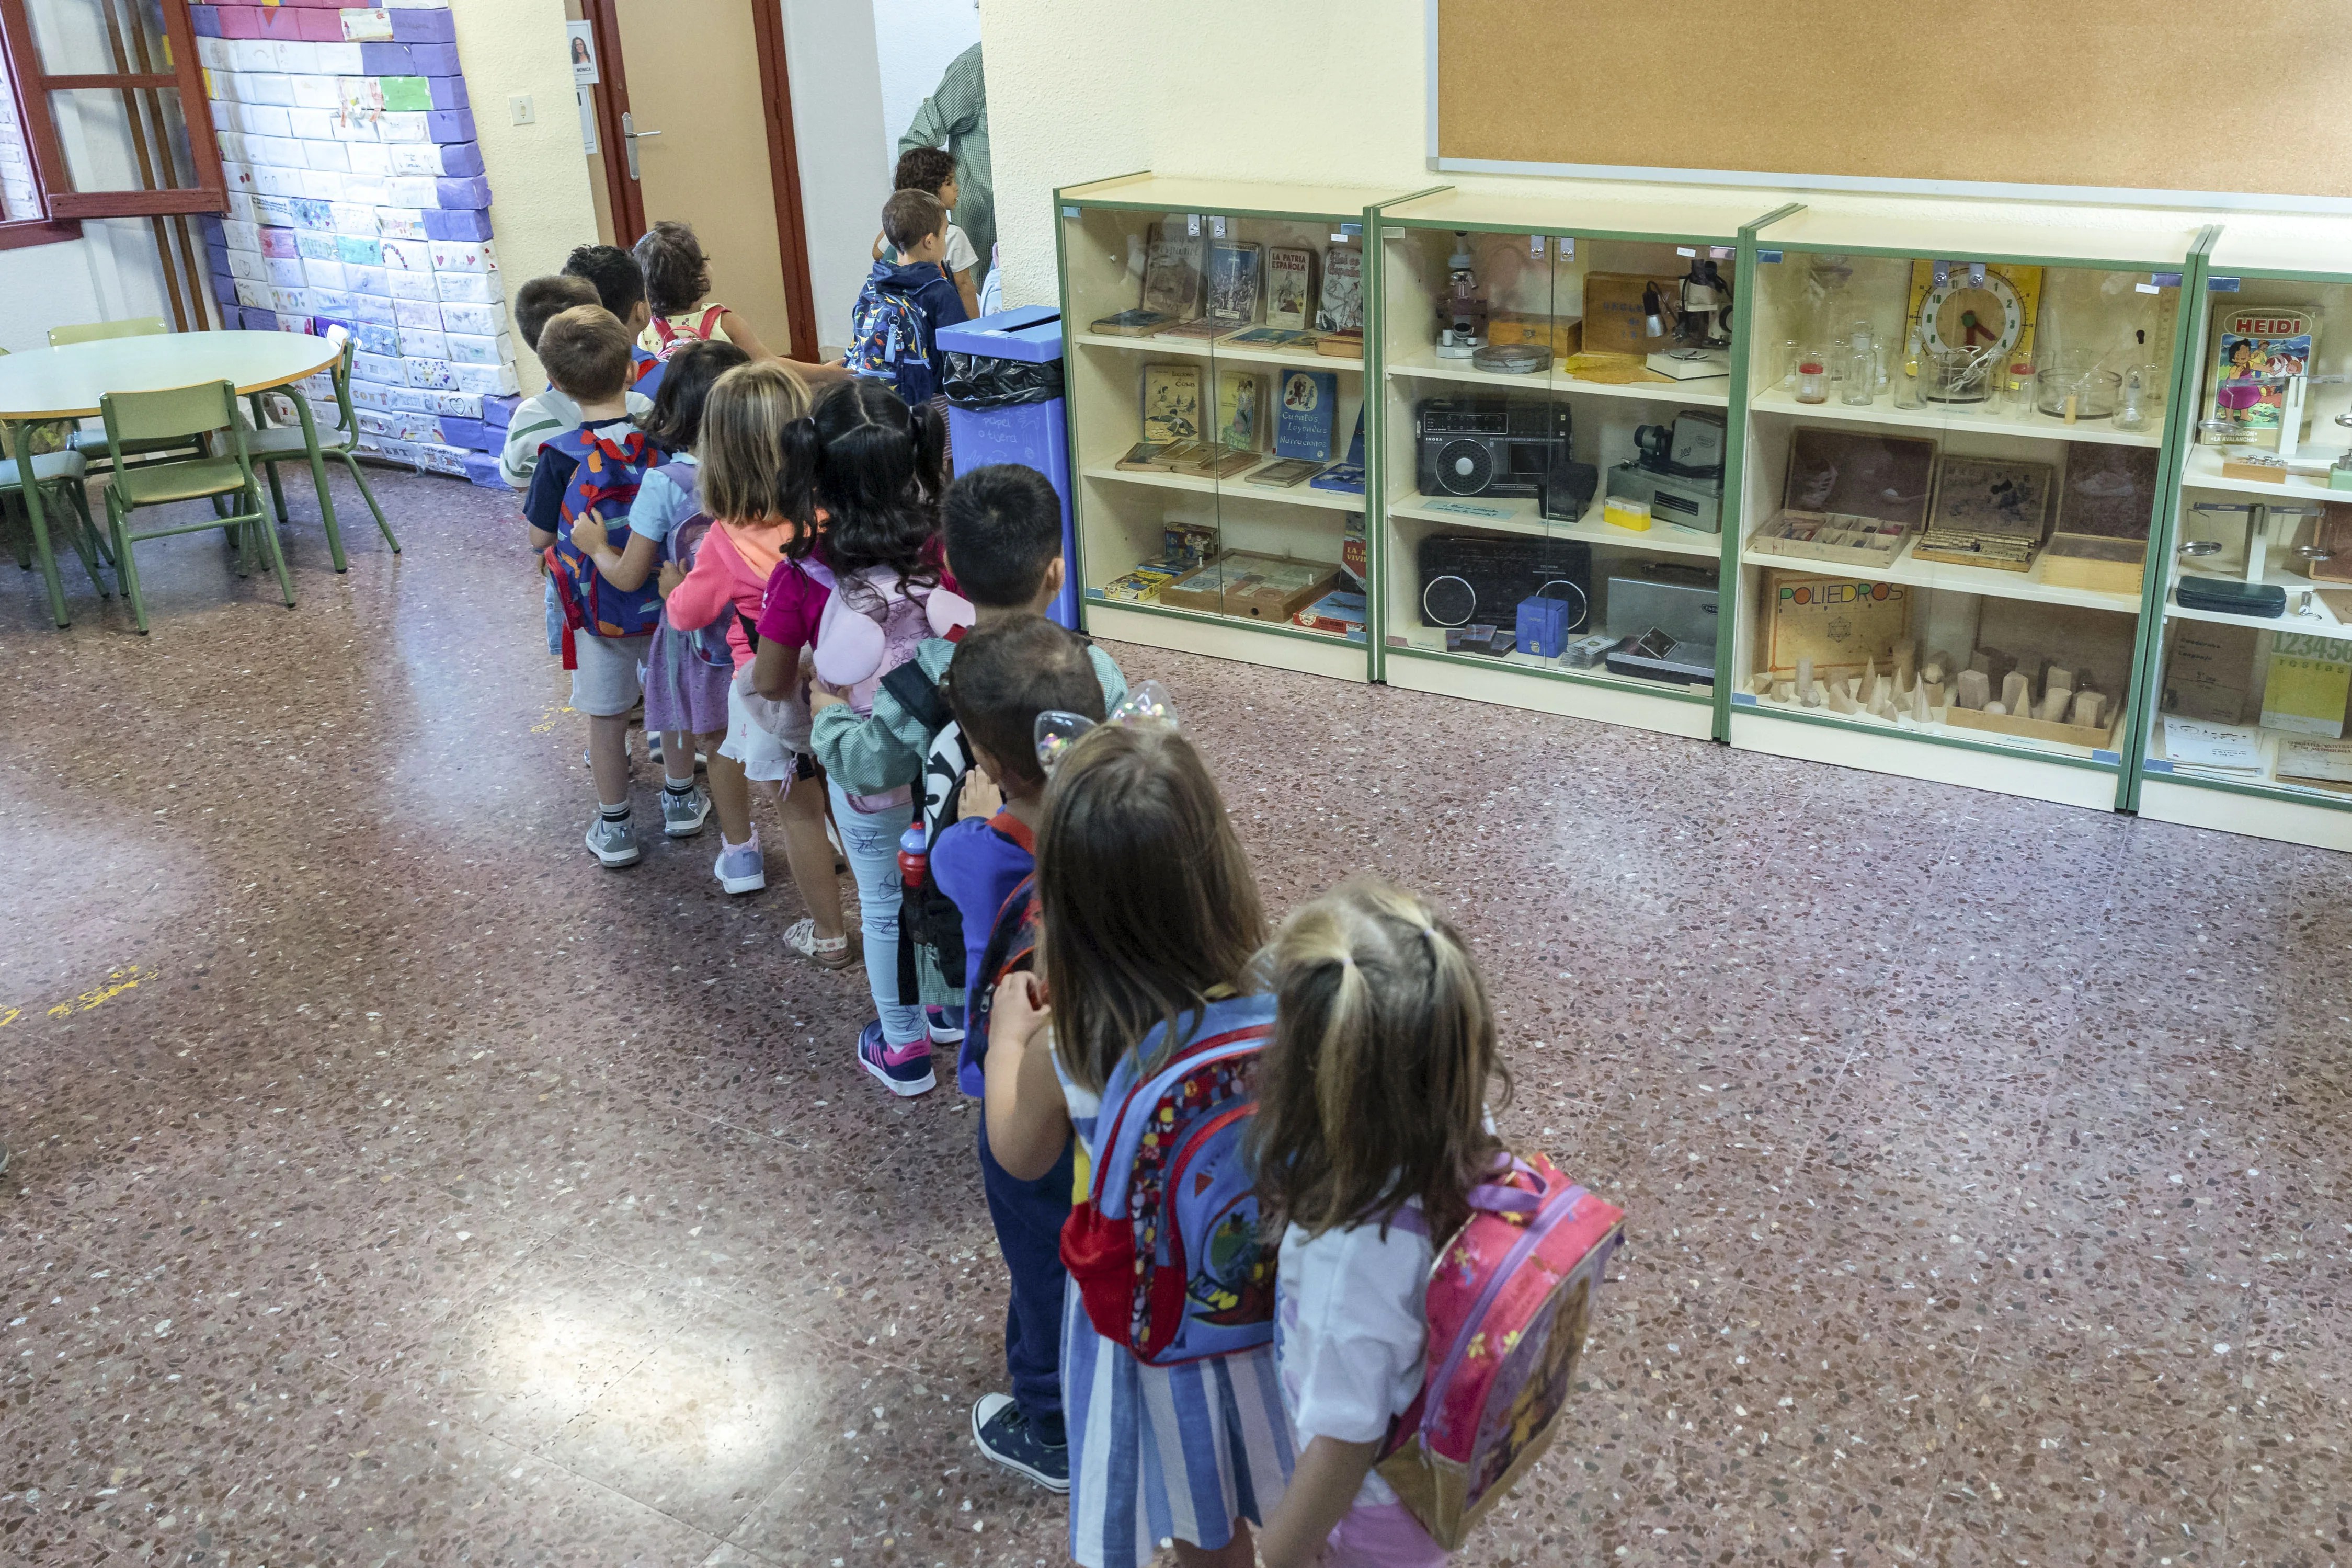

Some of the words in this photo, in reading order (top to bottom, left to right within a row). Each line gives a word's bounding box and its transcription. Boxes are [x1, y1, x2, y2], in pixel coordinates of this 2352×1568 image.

[1272, 252, 1280, 260] LA
[1283, 254, 1306, 263] PATRIA
[1272, 262, 1305, 271] ESPAÑOLA
[2006, 299, 2013, 308] 2
[2009, 319, 2015, 329] 3
[2235, 318, 2301, 335] HEIDI
[2001, 339, 2007, 349] 4
[1280, 436, 1327, 448] Narraciones
[1779, 582, 1903, 606] POLIEDROS
[2279, 658, 2345, 674] restas
